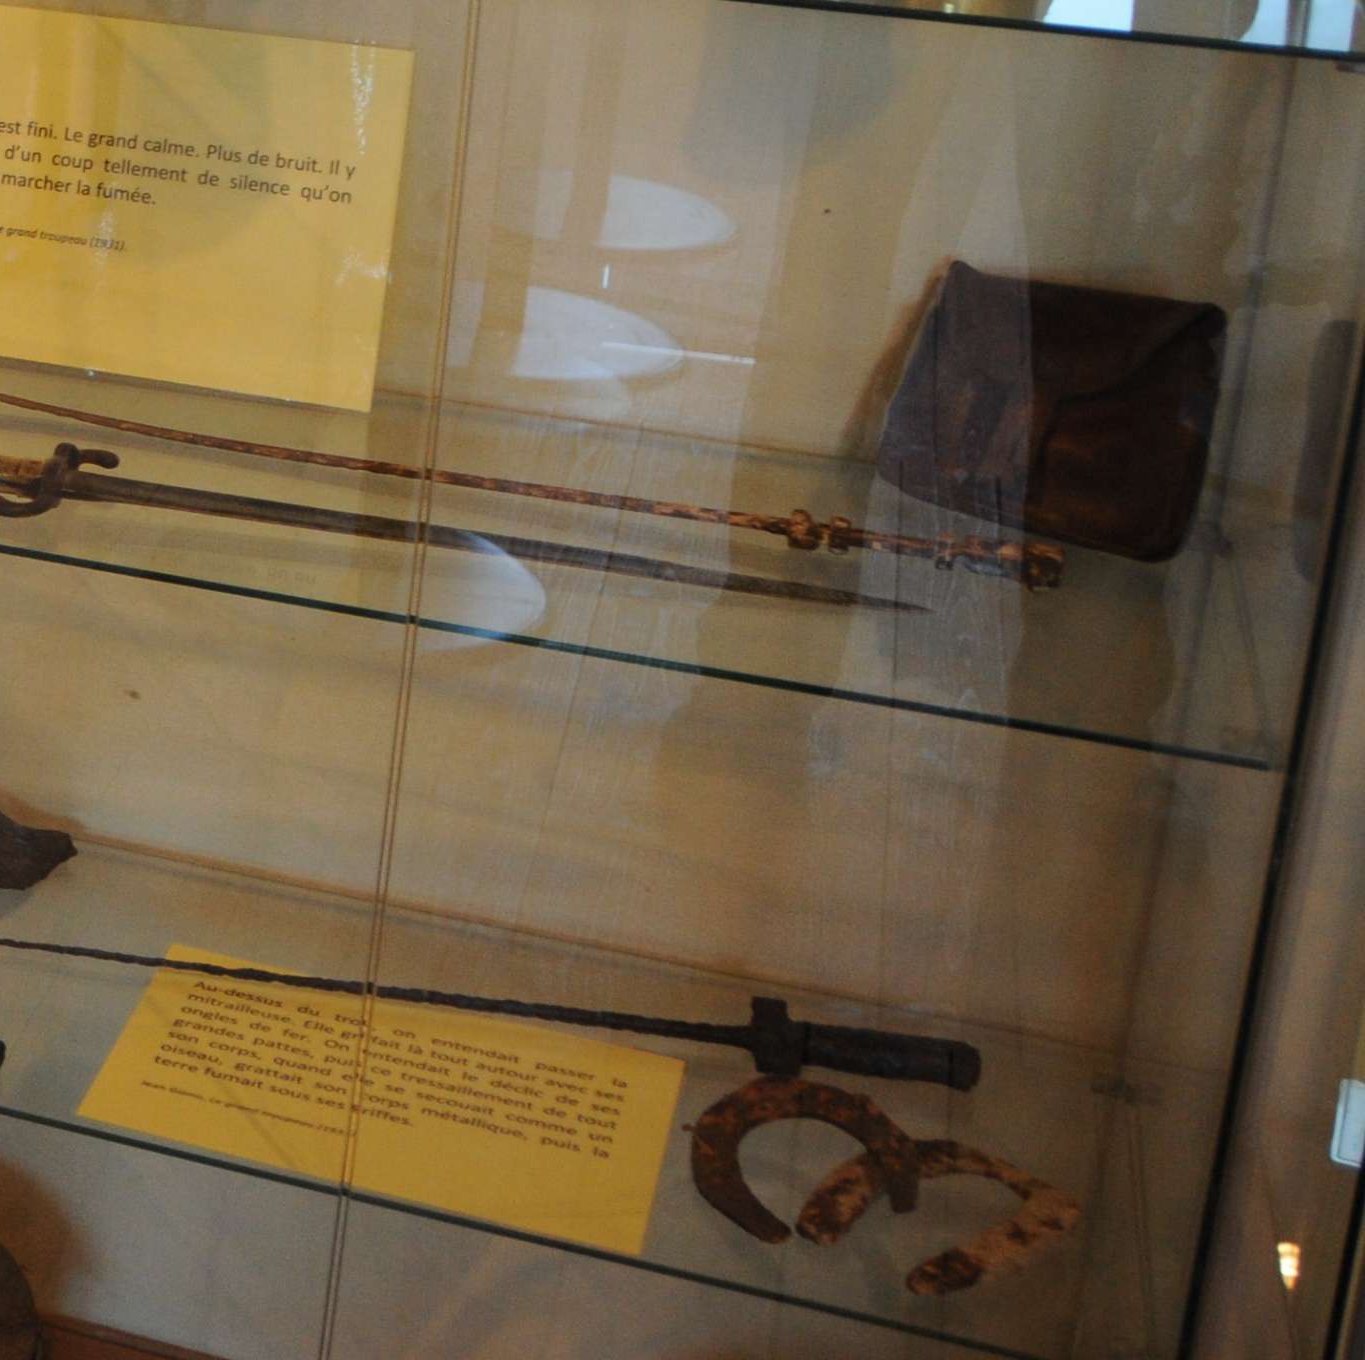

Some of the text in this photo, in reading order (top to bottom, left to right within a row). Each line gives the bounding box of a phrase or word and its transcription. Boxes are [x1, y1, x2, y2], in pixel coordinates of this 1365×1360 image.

[1, 172, 72, 193] marcher
[76, 180, 91, 196] la
[96, 182, 156, 205] fumée.
[27, 121, 58, 140] fini.
[64, 127, 83, 143] Le
[88, 133, 137, 149] grand
[143, 138, 199, 157] calme.
[206, 144, 242, 163] Plus
[248, 150, 270, 167] de
[276, 153, 322, 173] bruit.
[329, 159, 340, 175] Il
[345, 164, 356, 180] y
[51, 153, 93, 173] coup
[103, 159, 188, 183] tellement
[197, 170, 219, 186] de
[230, 175, 290, 196] silence
[6, 227, 38, 239] grand
[39, 230, 87, 246] troupeau
[172, 1018, 245, 1041] grandes
[253, 1037, 314, 1059] pattes,
[370, 1065, 391, 1077] ce
[400, 1073, 534, 1111] tressaillement
[543, 1106, 567, 1119] de
[577, 1114, 617, 1130] tout
[181, 1006, 238, 1025] ongles
[249, 1021, 271, 1033] de
[283, 1028, 310, 1042] fer.
[324, 1040, 350, 1052] On
[462, 1072, 479, 1083] le
[490, 1078, 544, 1099] déclic
[556, 1094, 579, 1106] de
[592, 1103, 621, 1116] ses
[193, 980, 283, 1008] Au-dessus
[297, 1005, 319, 1017] du
[393, 1028, 416, 1040] on
[432, 1038, 520, 1065] entendait
[534, 1062, 596, 1081] passer
[612, 1077, 628, 1089] la
[304, 1020, 335, 1035] Elle
[431, 1051, 469, 1067] tout
[476, 1062, 536, 1082] autour
[544, 1079, 588, 1095] avec
[596, 1090, 624, 1103] ses
[154, 1055, 199, 1073] terre
[204, 1066, 264, 1089] fumait
[270, 1086, 310, 1101] sous
[317, 1097, 345, 1110] ses
[160, 1043, 223, 1066] oiseau,
[234, 1062, 303, 1085] grattait
[315, 1082, 347, 1095] son
[421, 1106, 527, 1140] métallique,
[541, 1136, 580, 1153] puis
[593, 1147, 610, 1159] la
[168, 1031, 199, 1044] son
[209, 1040, 262, 1060] corps,
[272, 1056, 332, 1078] quand
[384, 1083, 406, 1095] se
[416, 1091, 495, 1116] secouait
[505, 1113, 578, 1136] comme
[588, 1132, 614, 1144] un
